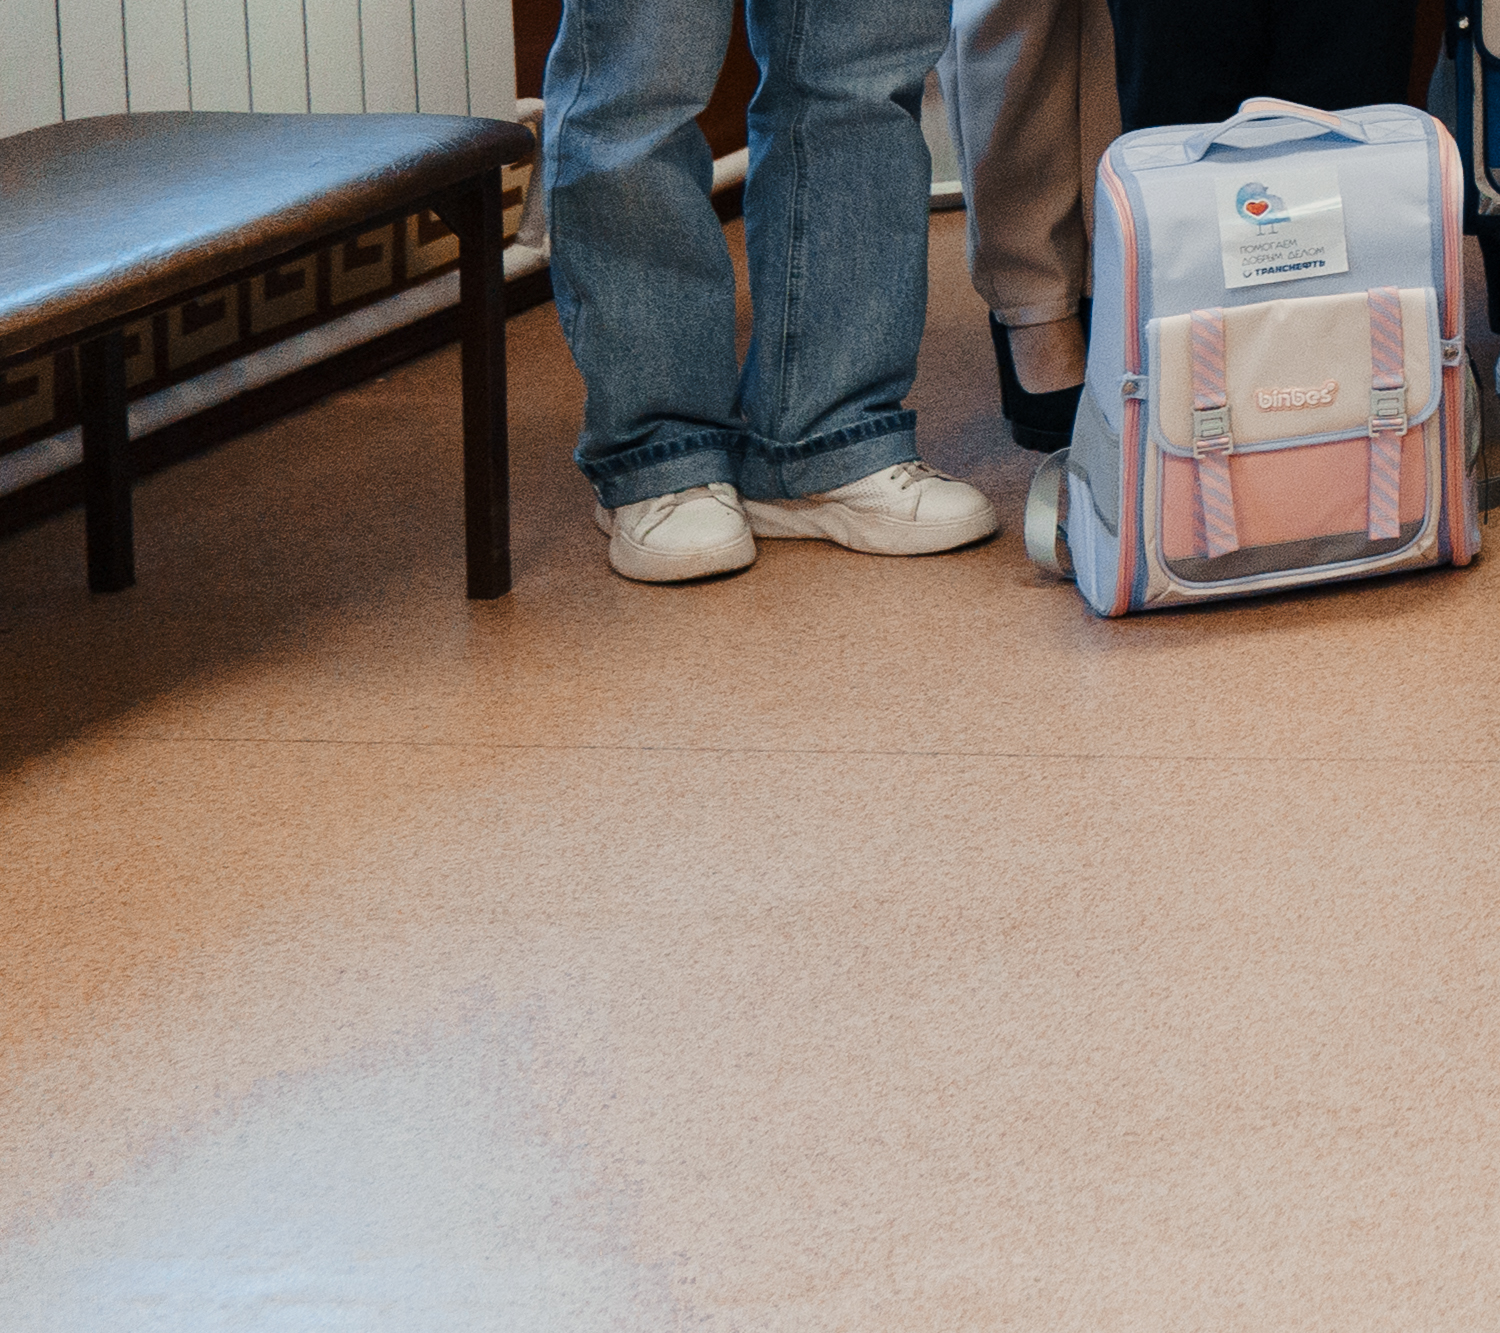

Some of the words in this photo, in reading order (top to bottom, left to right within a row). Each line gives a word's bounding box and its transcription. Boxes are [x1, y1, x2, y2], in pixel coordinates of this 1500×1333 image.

[1239, 239, 1298, 255] ПОМОГАЕМ
[1241, 252, 1284, 267] ДОБРЫМ
[1287, 246, 1326, 261] ДЕЛОМ
[1255, 260, 1326, 276] ТРАНСНЕФТЬ
[1257, 382, 1336, 409] binbes
